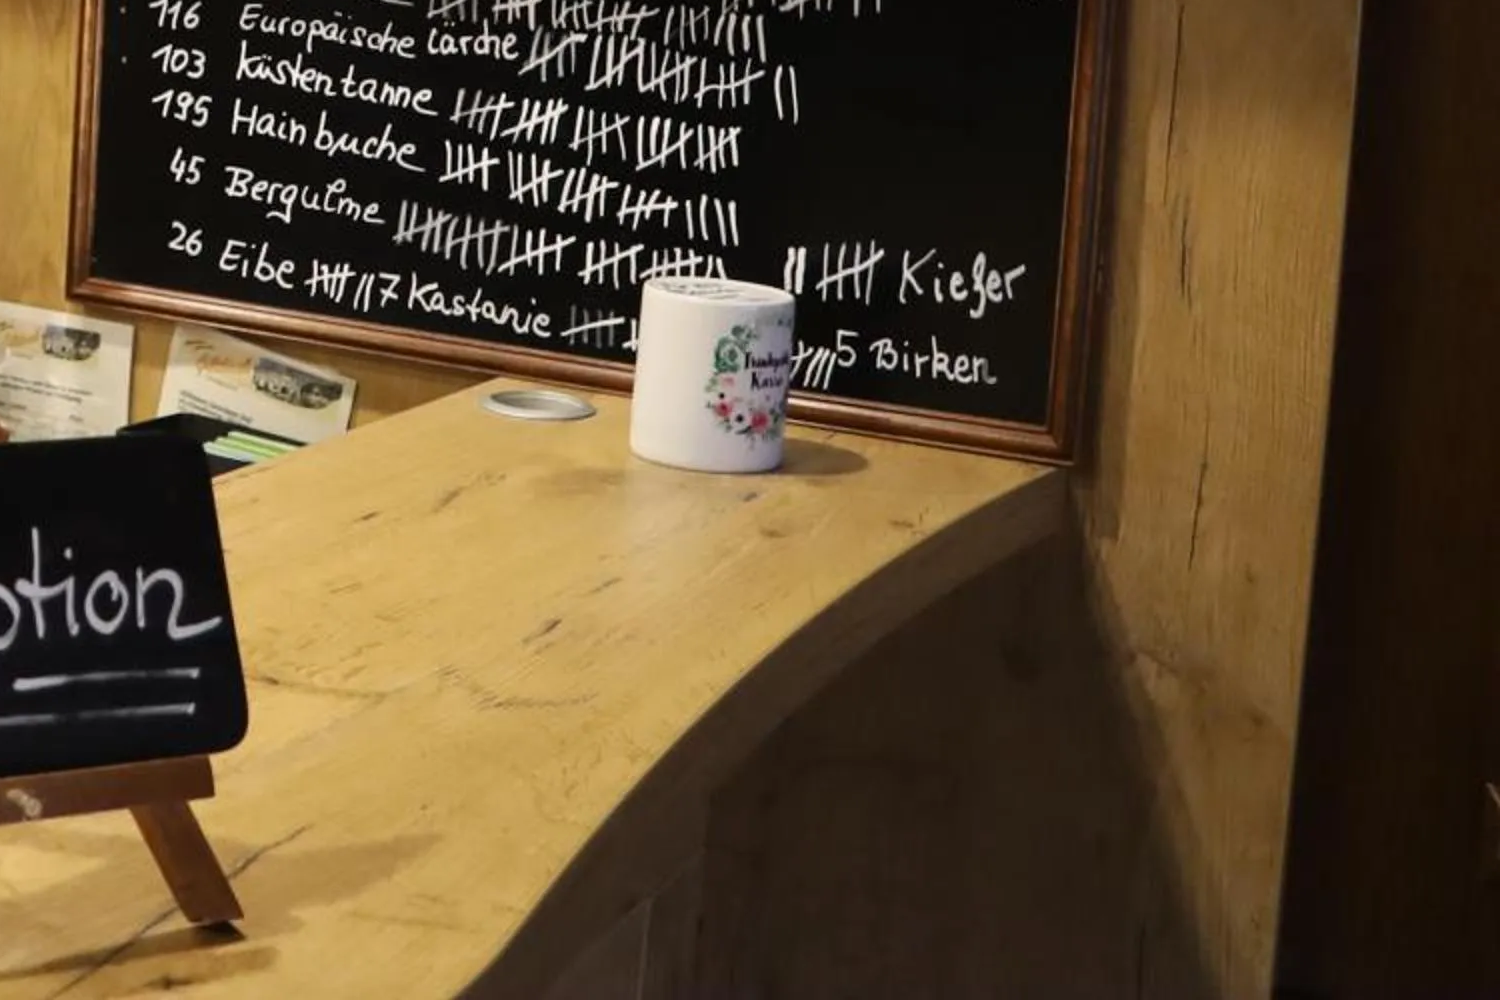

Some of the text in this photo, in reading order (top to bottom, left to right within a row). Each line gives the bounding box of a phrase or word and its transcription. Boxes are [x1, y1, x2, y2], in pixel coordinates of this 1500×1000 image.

[151, 43, 207, 79] 103
[238, 3, 417, 59] Europäische
[151, 88, 426, 172] 195 Hainbuche
[169, 147, 386, 223] 45 Bergulme
[167, 221, 203, 257] 26
[218, 239, 295, 290] Eibe
[408, 272, 552, 338] Kastanie
[899, 250, 1027, 319] Kiefer
[835, 329, 998, 385] 5 Birken
